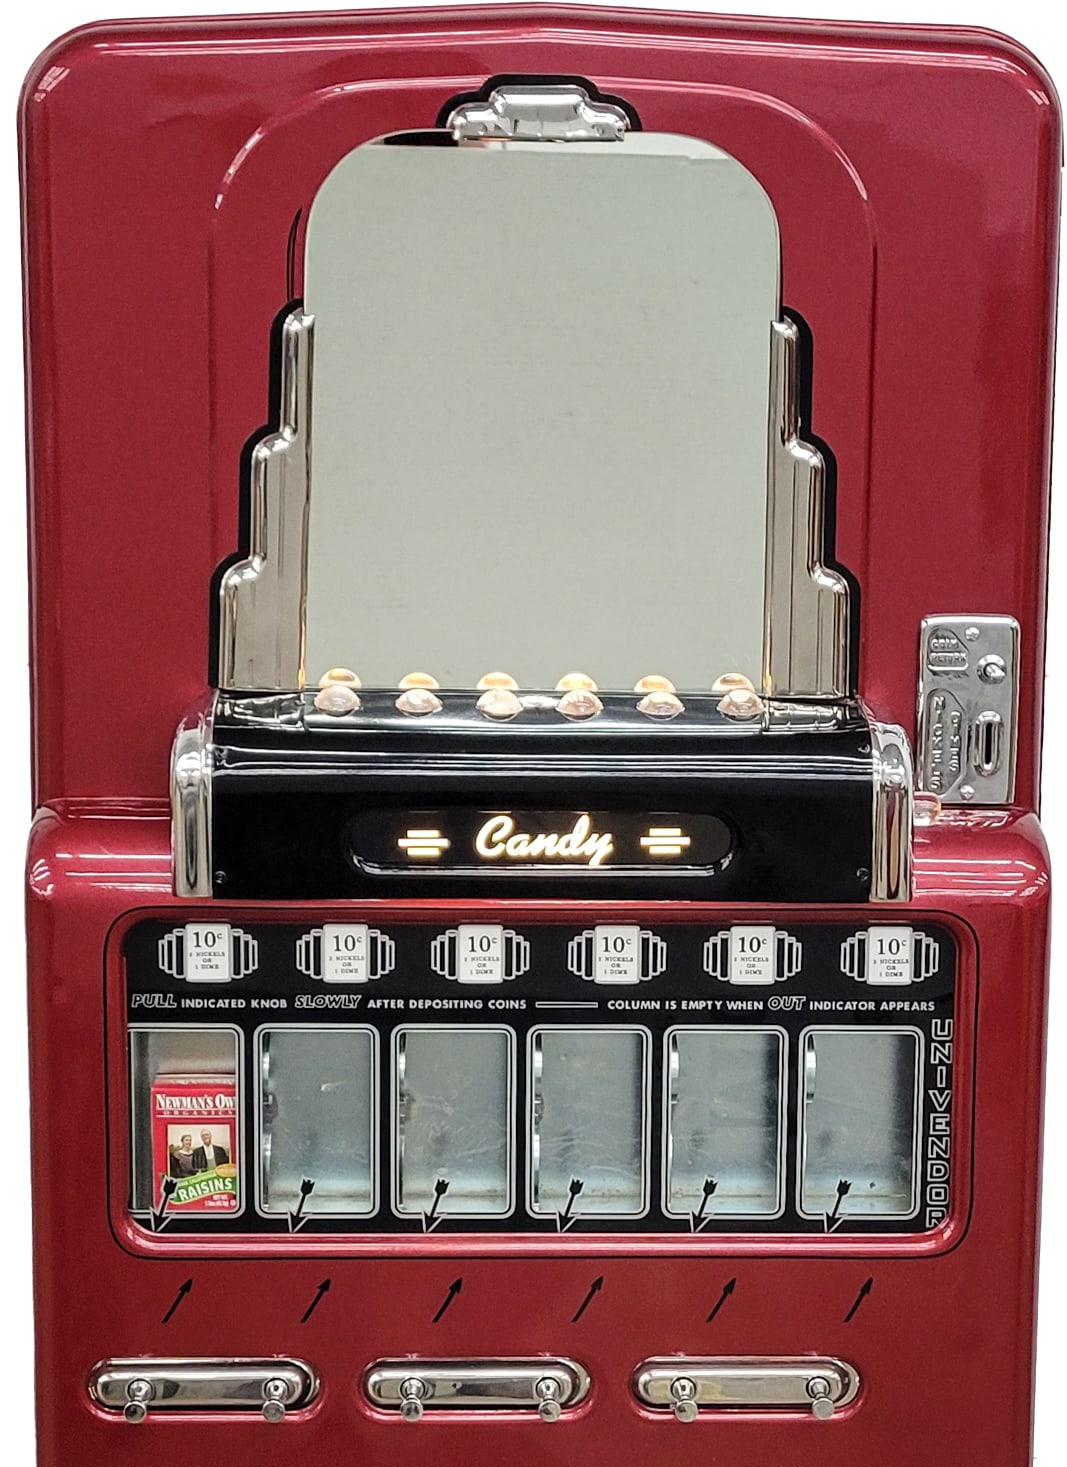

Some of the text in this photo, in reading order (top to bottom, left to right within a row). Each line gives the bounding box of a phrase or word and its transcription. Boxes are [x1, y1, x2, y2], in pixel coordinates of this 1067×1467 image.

[475, 814, 615, 866] Candy
[131, 994, 527, 1010] PULL INDICATED KNOB SLOWLY AFTER DEPOSITING COINS
[607, 996, 936, 1012] COLUMN IS EMPTY WHEN OUT INDICATOR APPEARS
[155, 1093, 236, 1109] NEWMAN'S OW
[925, 1018, 953, 1228] UNIVENDOR
[178, 1178, 232, 1201] RAISINS
